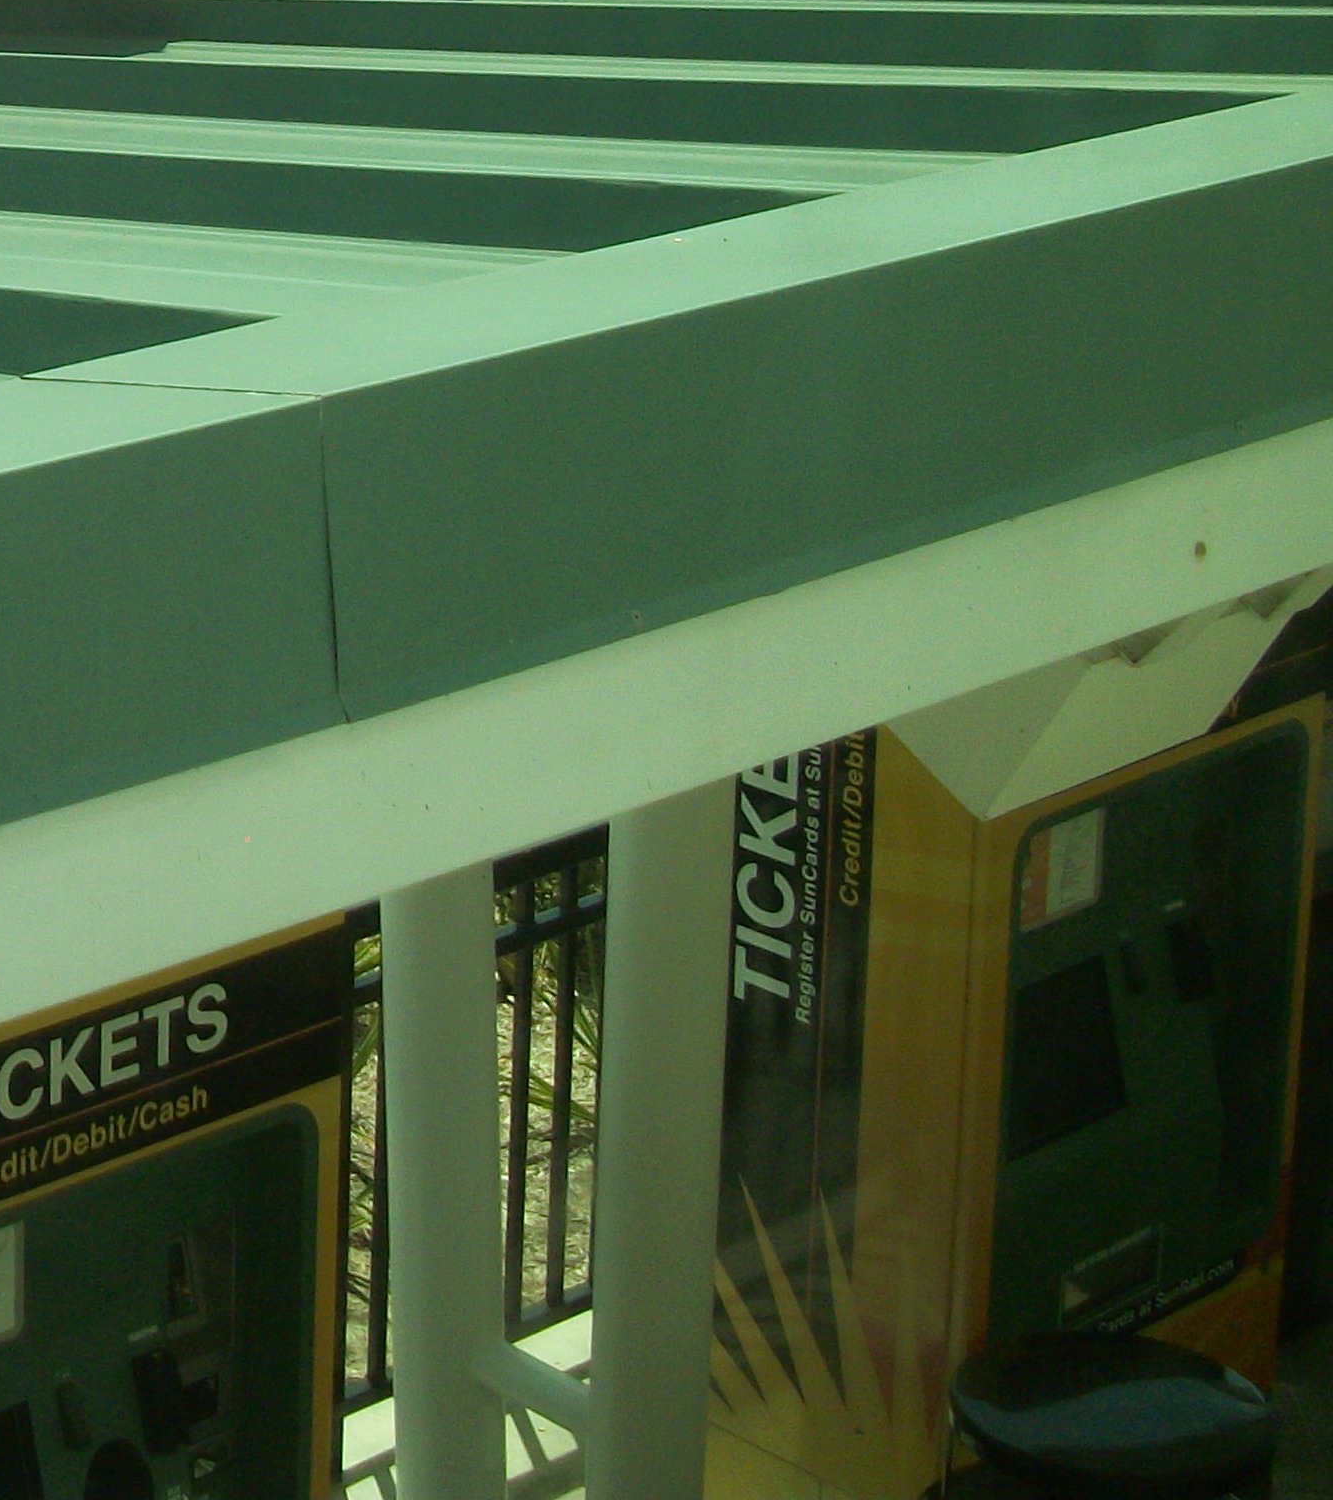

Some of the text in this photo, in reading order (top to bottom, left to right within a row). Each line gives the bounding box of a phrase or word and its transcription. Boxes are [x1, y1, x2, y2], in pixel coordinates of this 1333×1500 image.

[806, 787, 821, 810] at
[734, 751, 799, 1000] TICKE
[800, 815, 821, 926] SunCards
[795, 932, 817, 1024] Register
